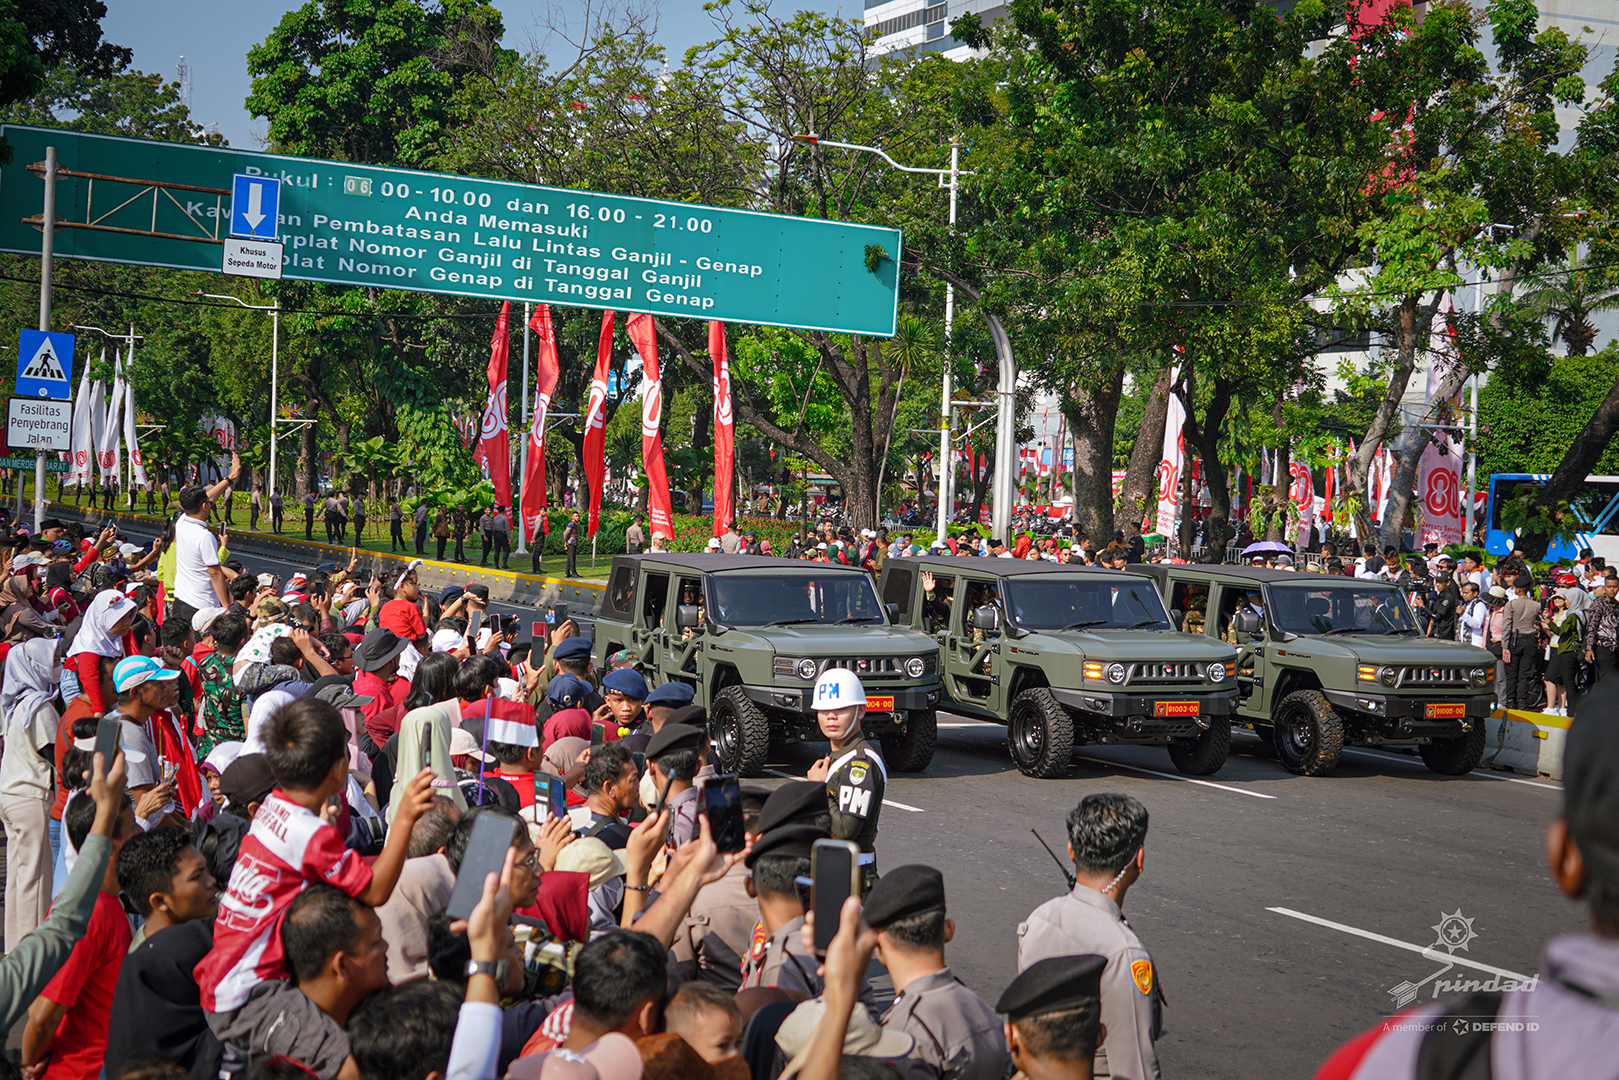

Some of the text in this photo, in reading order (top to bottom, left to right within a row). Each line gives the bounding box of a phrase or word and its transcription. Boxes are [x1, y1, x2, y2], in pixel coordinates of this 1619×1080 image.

[404, 206, 588, 239] Anda Memasuki
[506, 198, 550, 215] dan
[566, 203, 626, 223] 16.00
[653, 213, 713, 233] 21.00
[239, 246, 267, 257] Khusus
[313, 214, 460, 243] Pembatasan
[474, 232, 522, 250] Lalu
[533, 238, 601, 258] Lintas
[611, 247, 672, 268] Ganjil
[696, 256, 763, 278] Genap
[227, 257, 277, 270] Sepeda Motor
[349, 238, 427, 259] Nomor
[438, 248, 502, 269] Ganjil
[512, 256, 532, 270] di
[543, 258, 629, 282] Tanggal
[642, 269, 702, 290] Ganjil
[338, 258, 417, 278] Nomor
[429, 267, 503, 289] Genap
[513, 275, 533, 290] di
[544, 278, 632, 301] Tanggal
[646, 289, 715, 310] Genap
[20, 404, 61, 417] Fasilitas
[10, 417, 69, 433] Penyebrang
[26, 433, 52, 444] Jalan
[819, 683, 840, 701] PM
[839, 785, 872, 817] PM
